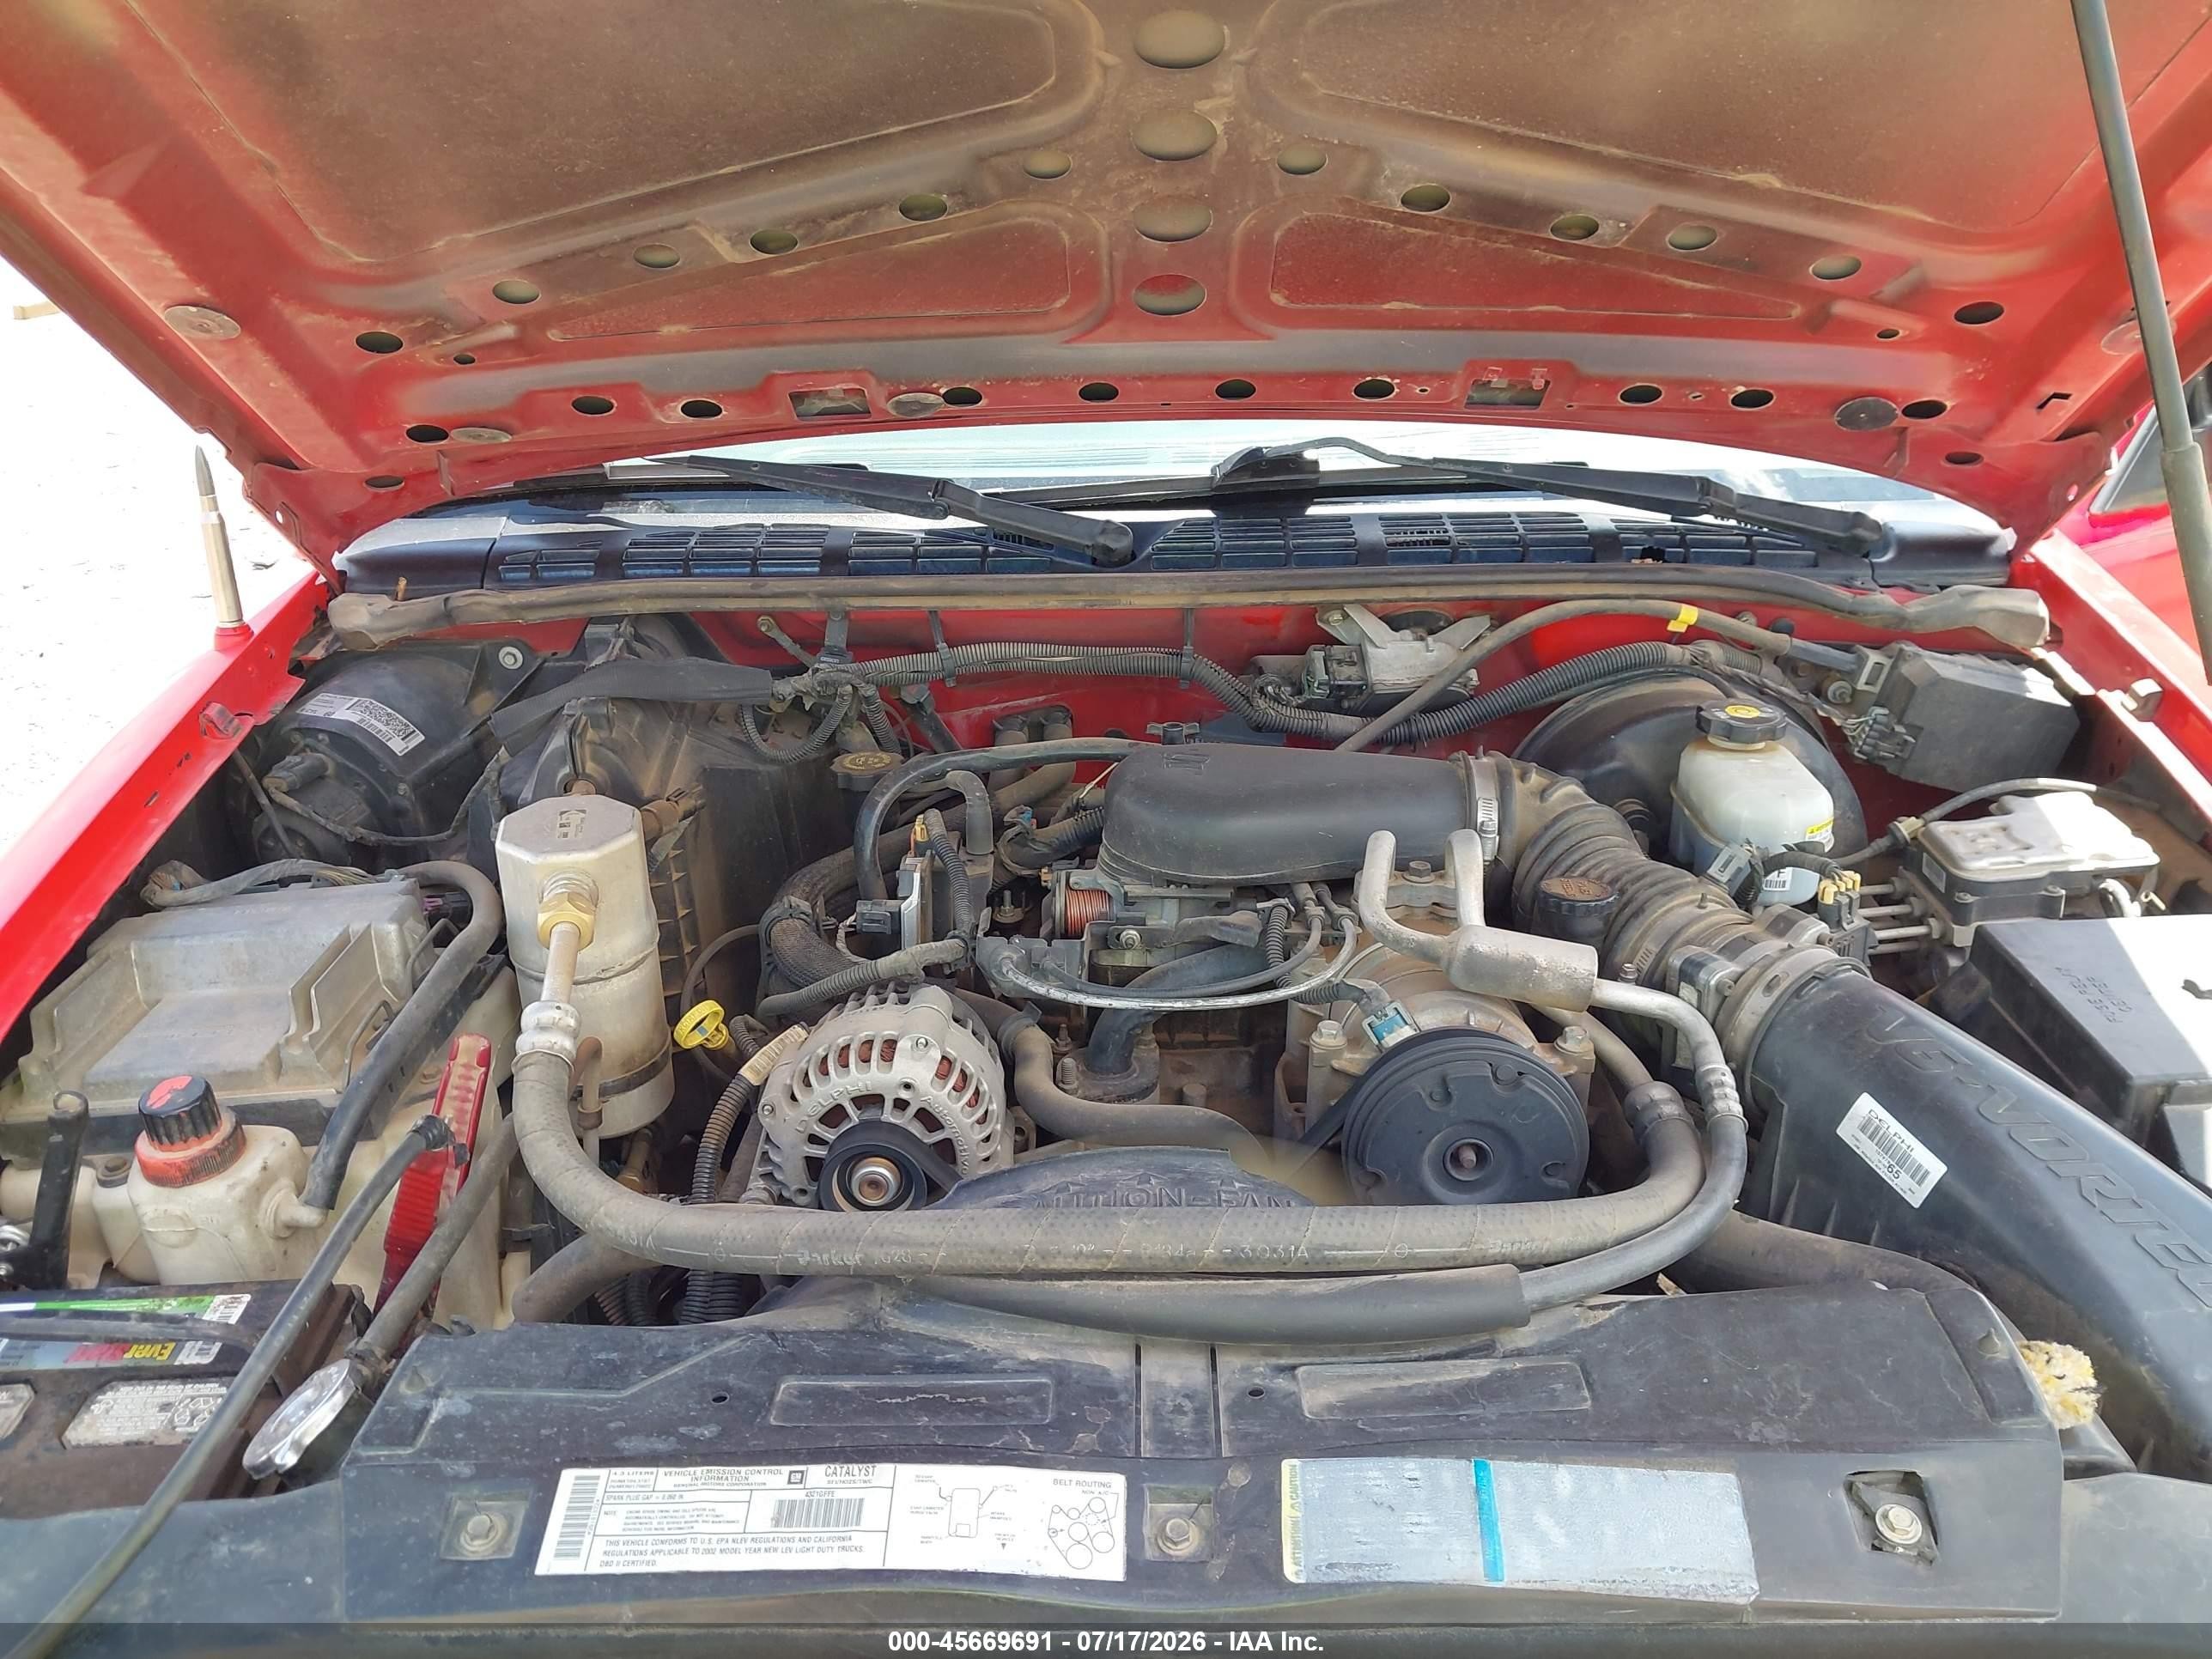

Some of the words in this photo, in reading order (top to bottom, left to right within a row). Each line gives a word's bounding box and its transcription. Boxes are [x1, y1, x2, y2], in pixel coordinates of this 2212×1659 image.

[795, 1080, 872, 1133] DELPHI
[920, 1095, 970, 1175] Automotive
[1868, 1109, 1915, 1153] DELPHI
[1887, 1163, 1903, 1180] 65
[1239, 1244, 1310, 1259] 3031A
[824, 1464, 877, 1477] CATALYST
[1053, 1478, 1073, 1486] BELT
[1075, 1479, 1112, 1489] ROUTING
